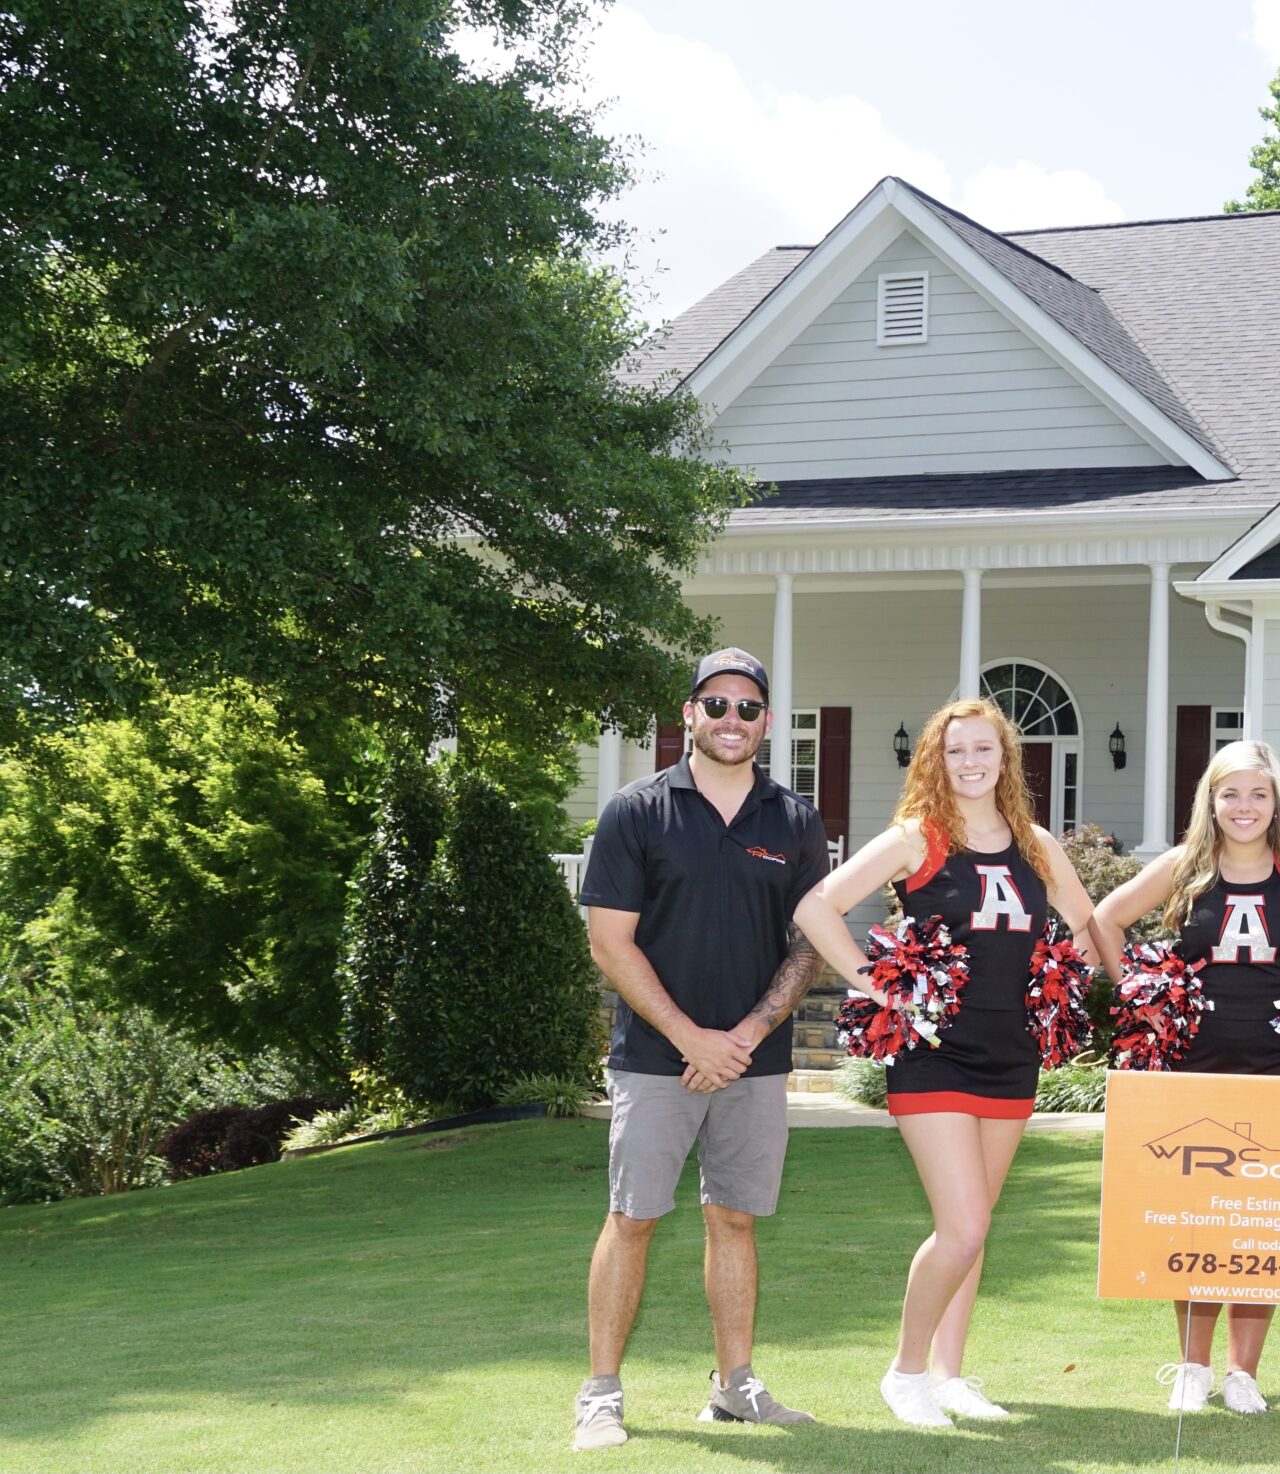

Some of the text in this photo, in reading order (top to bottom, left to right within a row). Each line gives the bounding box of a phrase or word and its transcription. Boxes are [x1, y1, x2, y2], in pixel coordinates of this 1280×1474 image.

[970, 864, 1032, 933] A
[1210, 894, 1278, 964] A
[1211, 1196, 1242, 1210] Free
[1144, 1211, 1176, 1225] Free
[1180, 1212, 1225, 1227] Storm
[1233, 1238, 1254, 1250] Call
